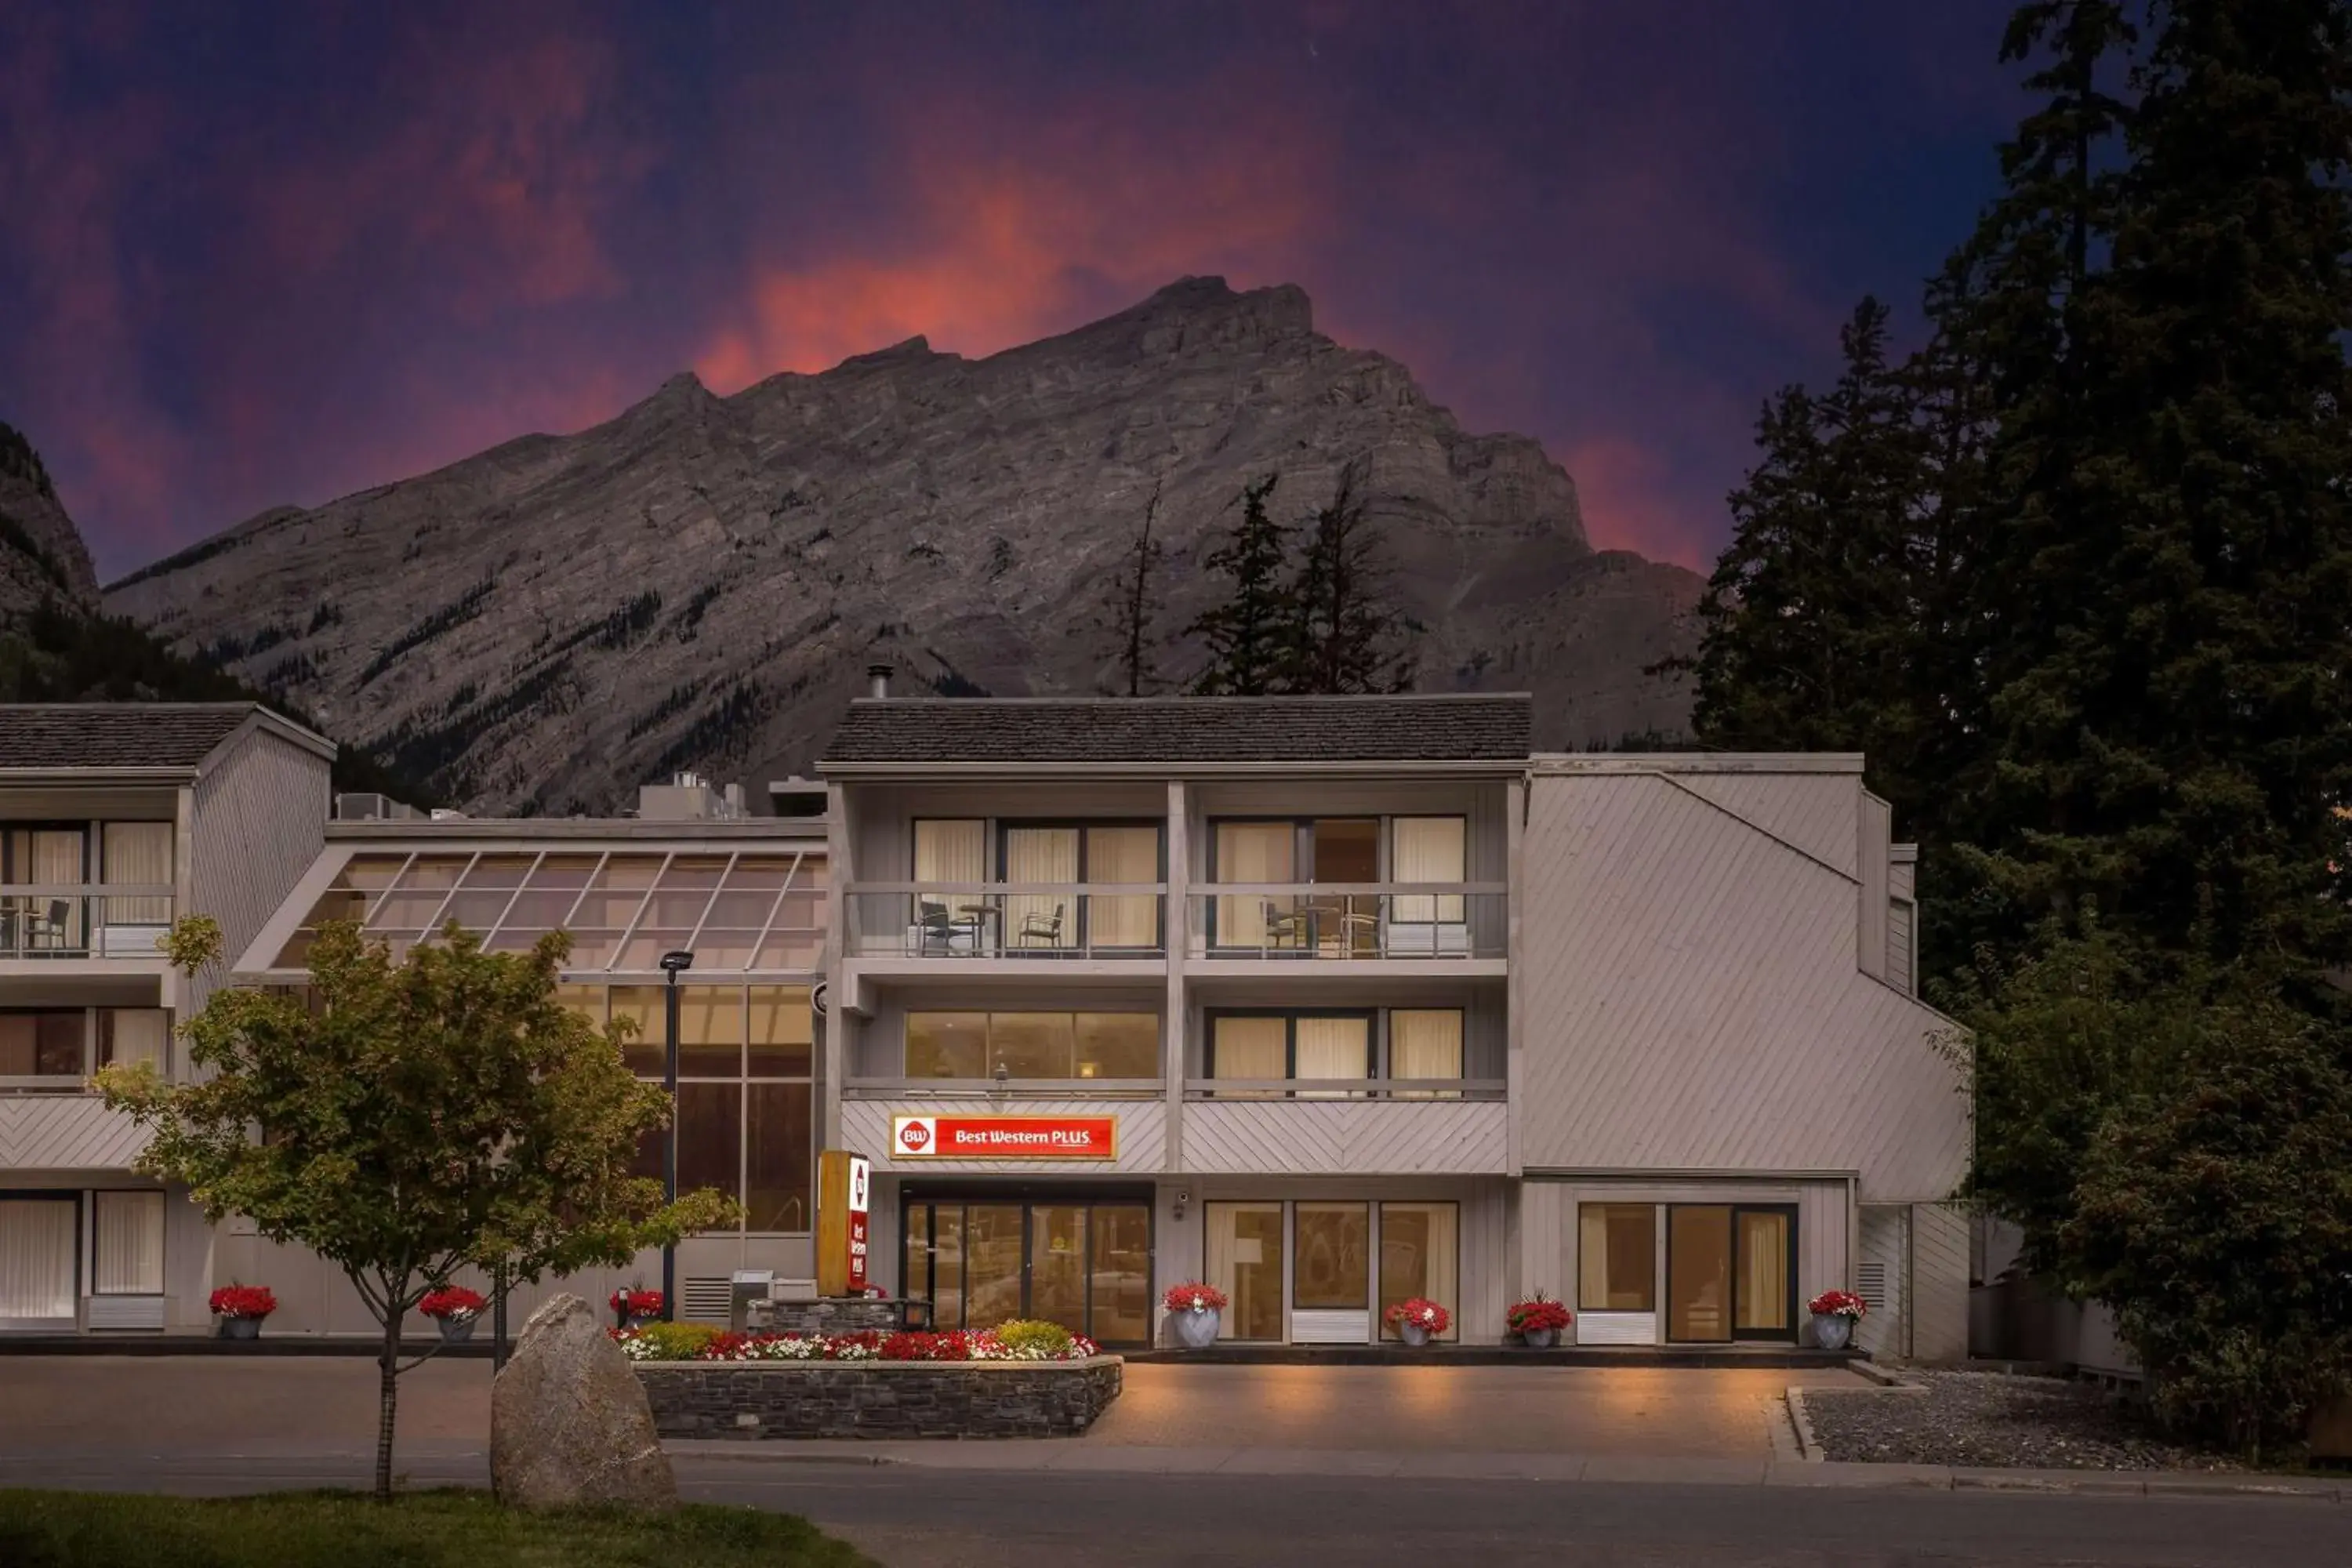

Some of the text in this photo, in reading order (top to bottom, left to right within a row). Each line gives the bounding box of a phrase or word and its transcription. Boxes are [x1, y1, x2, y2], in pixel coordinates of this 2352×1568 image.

[904, 1130, 927, 1142] BW
[956, 1130, 986, 1142] Best
[990, 1131, 1047, 1142] Western
